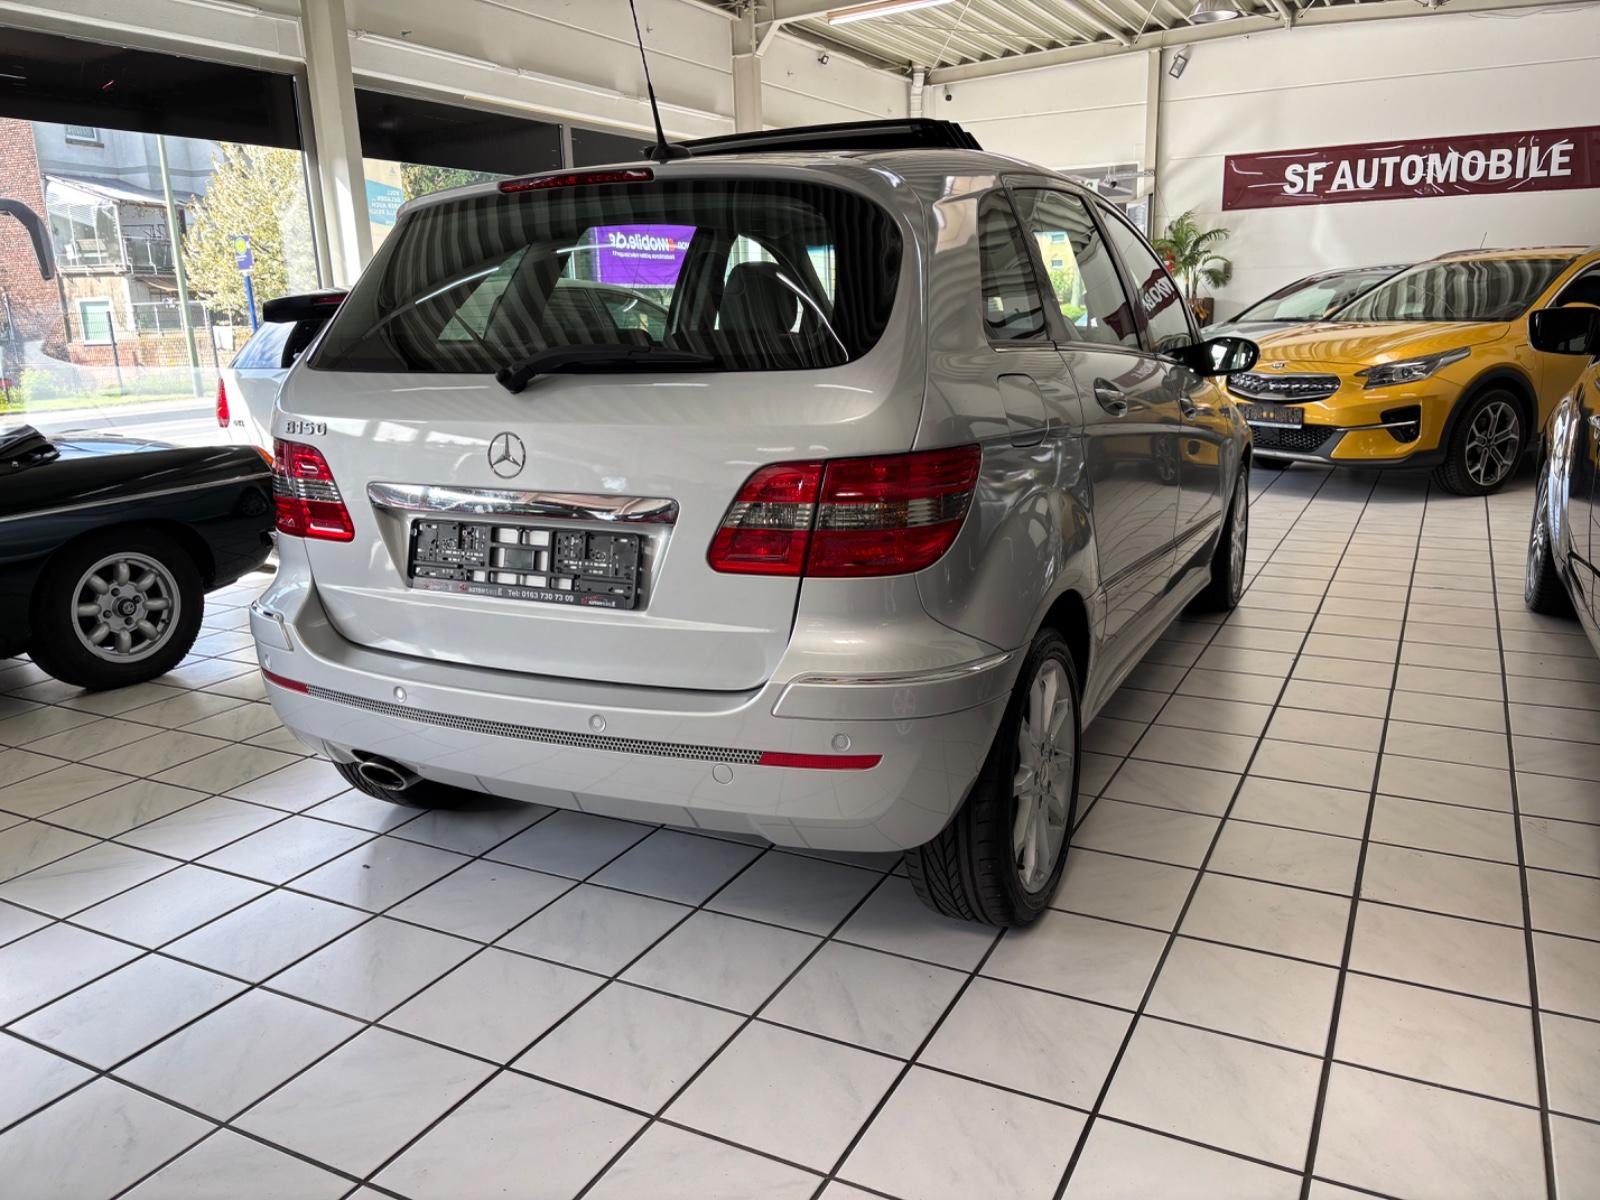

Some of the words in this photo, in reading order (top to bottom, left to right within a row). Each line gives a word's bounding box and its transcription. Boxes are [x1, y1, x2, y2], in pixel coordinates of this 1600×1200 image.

[1283, 162, 1324, 194] SF
[1332, 143, 1574, 189] AUTOMOBILE
[286, 420, 327, 436] B150
[521, 590, 539, 599] 0163
[539, 592, 553, 600] 730
[554, 593, 563, 601] 73
[565, 594, 574, 602] 09
